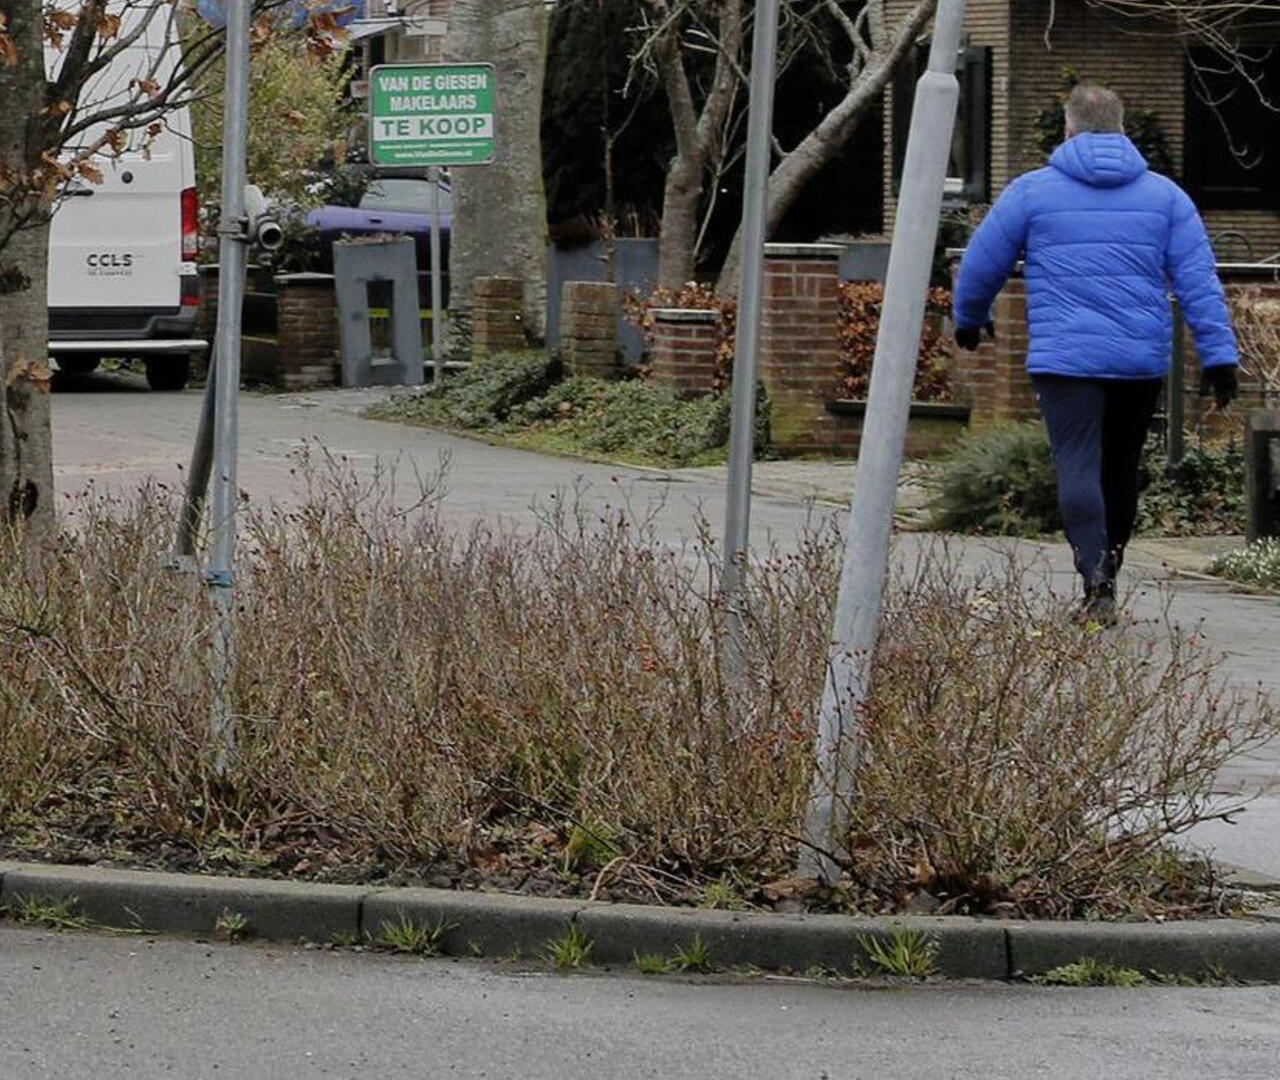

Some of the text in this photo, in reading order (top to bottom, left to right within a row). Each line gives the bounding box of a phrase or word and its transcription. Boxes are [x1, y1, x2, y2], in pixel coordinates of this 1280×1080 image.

[379, 74, 487, 92] VAN DE GIESEN
[390, 95, 477, 111] MAKELAARS
[380, 117, 486, 136] TE KOOP
[86, 253, 133, 268] CCLS
